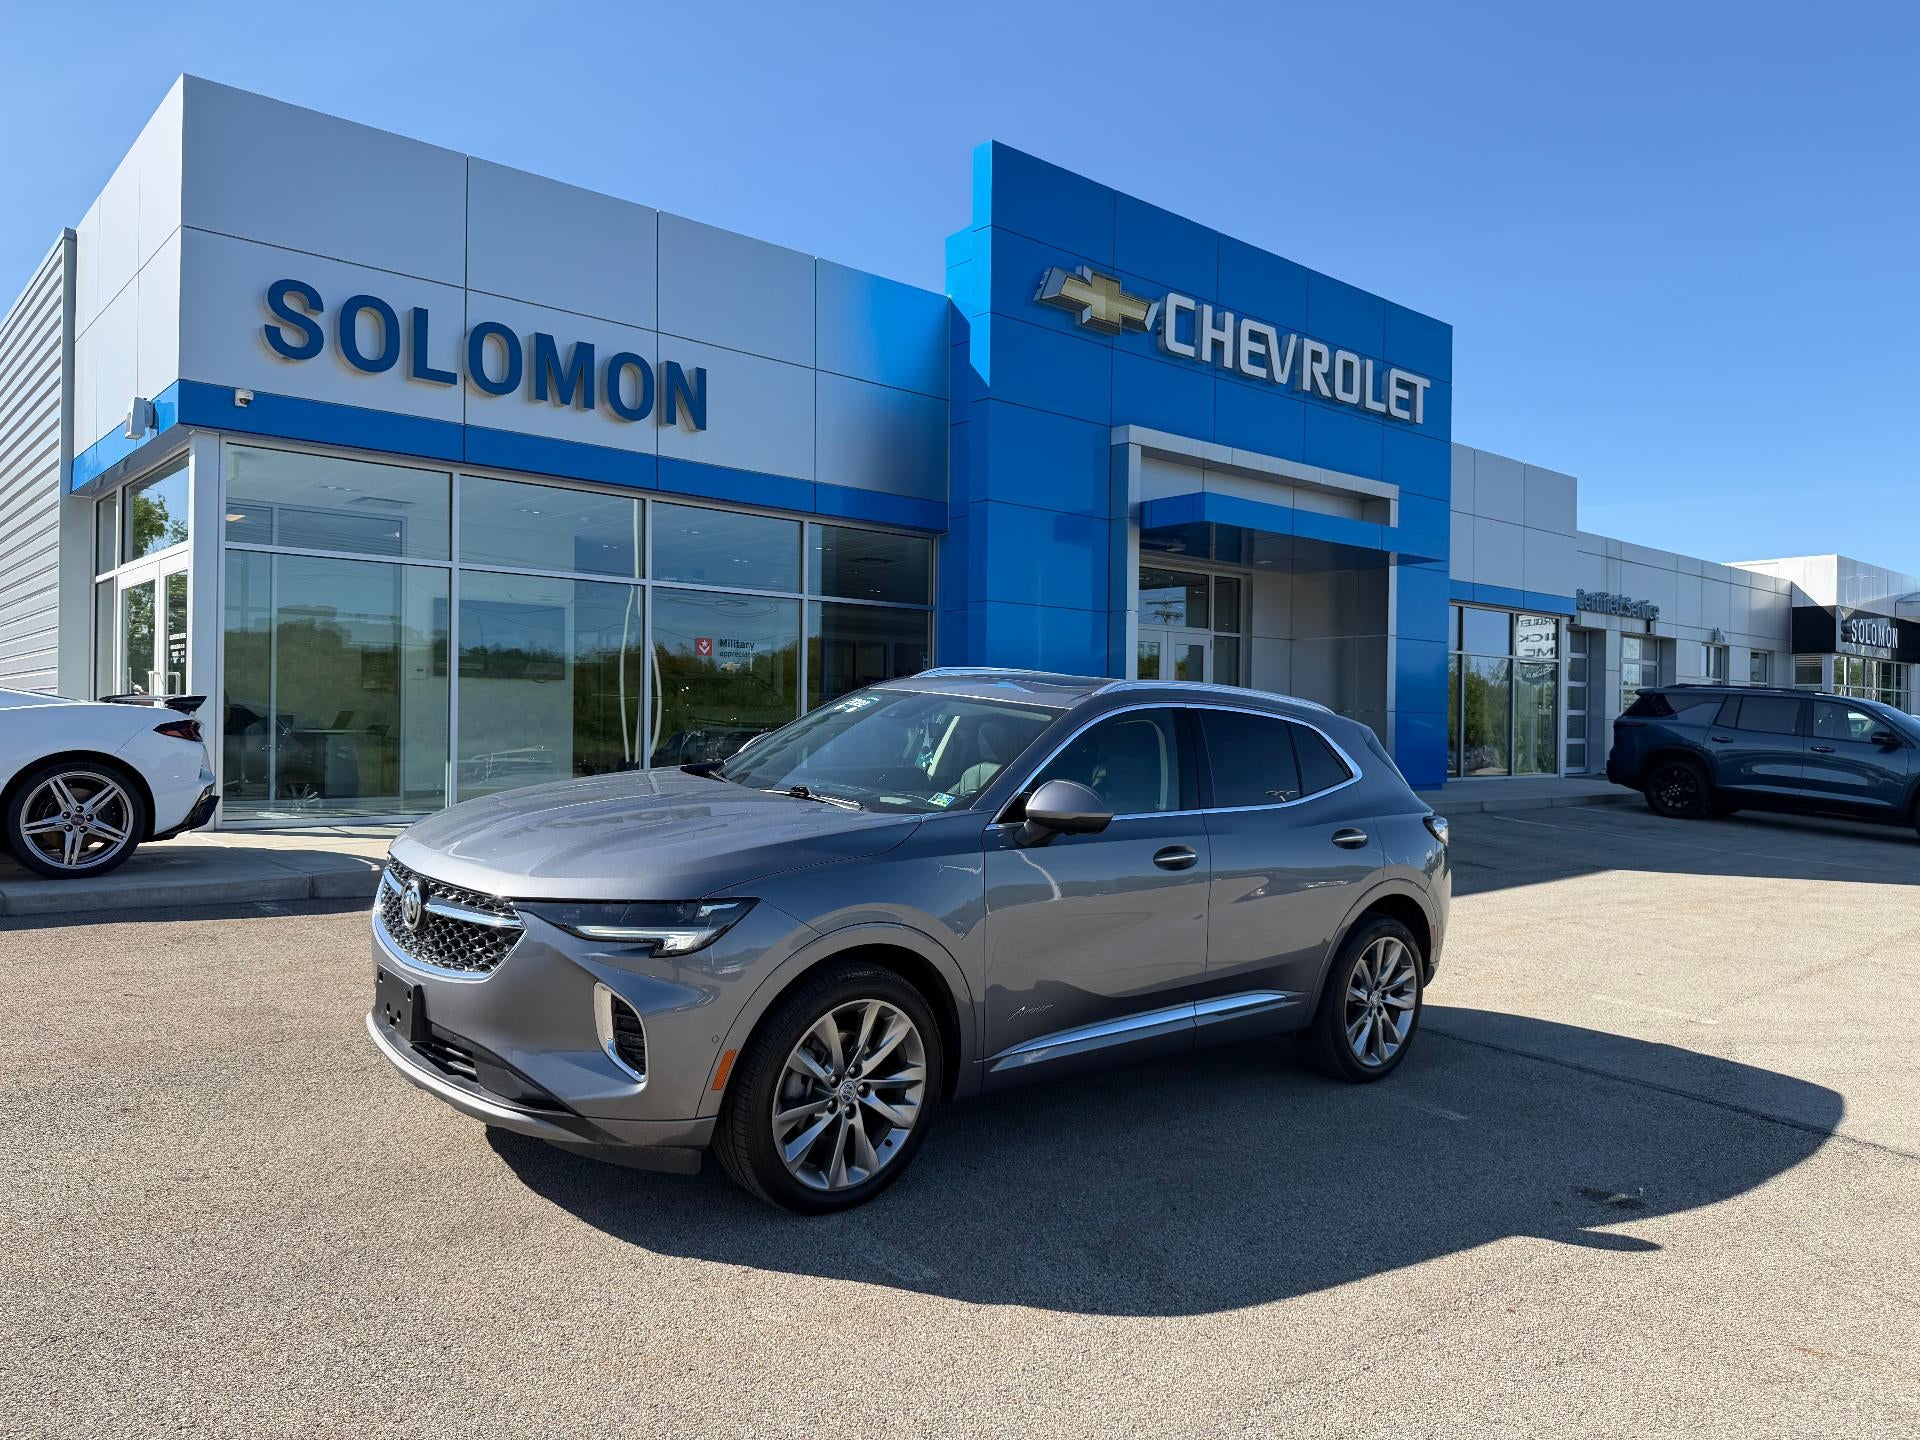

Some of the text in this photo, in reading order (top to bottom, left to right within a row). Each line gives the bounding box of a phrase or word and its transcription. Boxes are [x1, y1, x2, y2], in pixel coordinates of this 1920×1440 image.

[264, 278, 708, 432] SOLOMON
[1161, 292, 1430, 424] CHEVROLET
[1576, 589, 1659, 619] Certified Service
[719, 639, 755, 650] Military
[1851, 619, 1898, 648] SOLOMON
